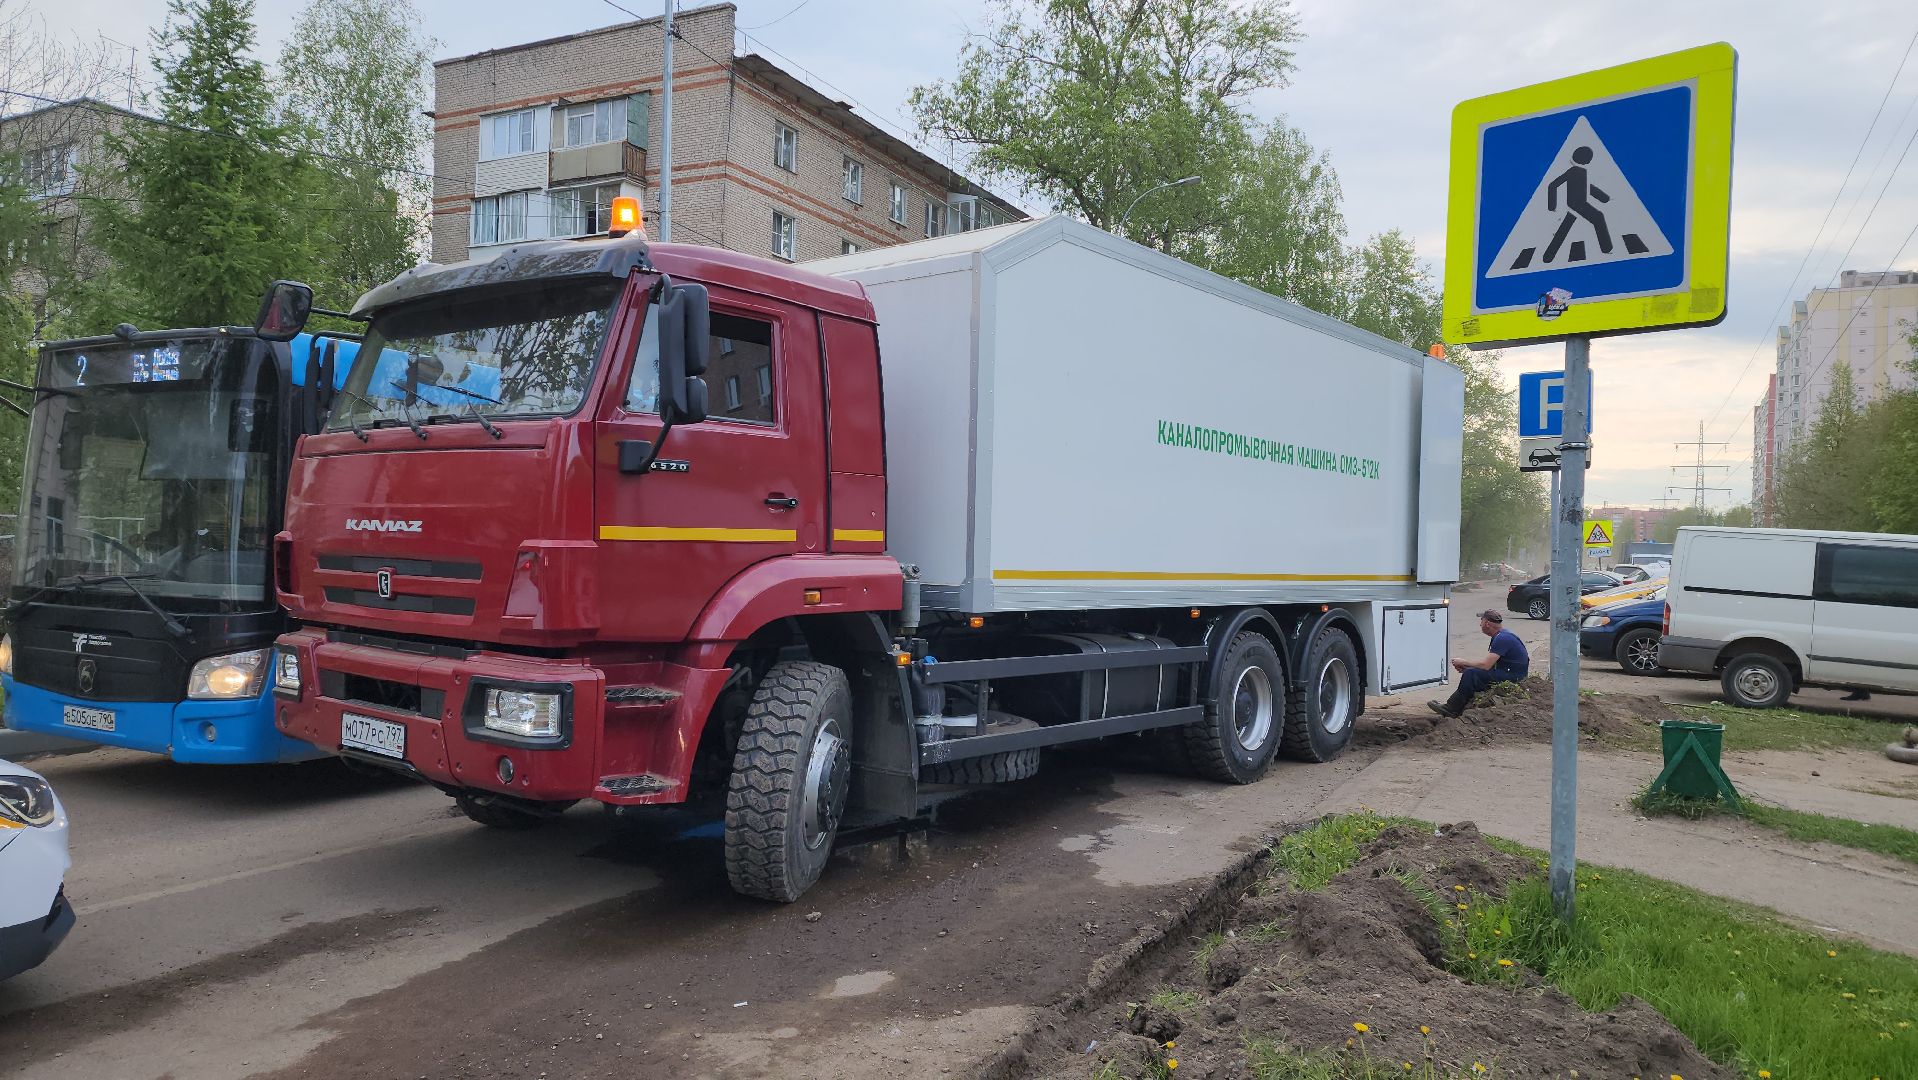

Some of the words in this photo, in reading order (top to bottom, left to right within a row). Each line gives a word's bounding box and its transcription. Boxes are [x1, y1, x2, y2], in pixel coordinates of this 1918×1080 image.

[77, 355, 87, 387] 2
[1158, 419, 1294, 466] КАНАЛОПРОМЫВОЧНАЯ
[1296, 446, 1338, 472] МАШИНА
[345, 518, 423, 532] KAMAZ
